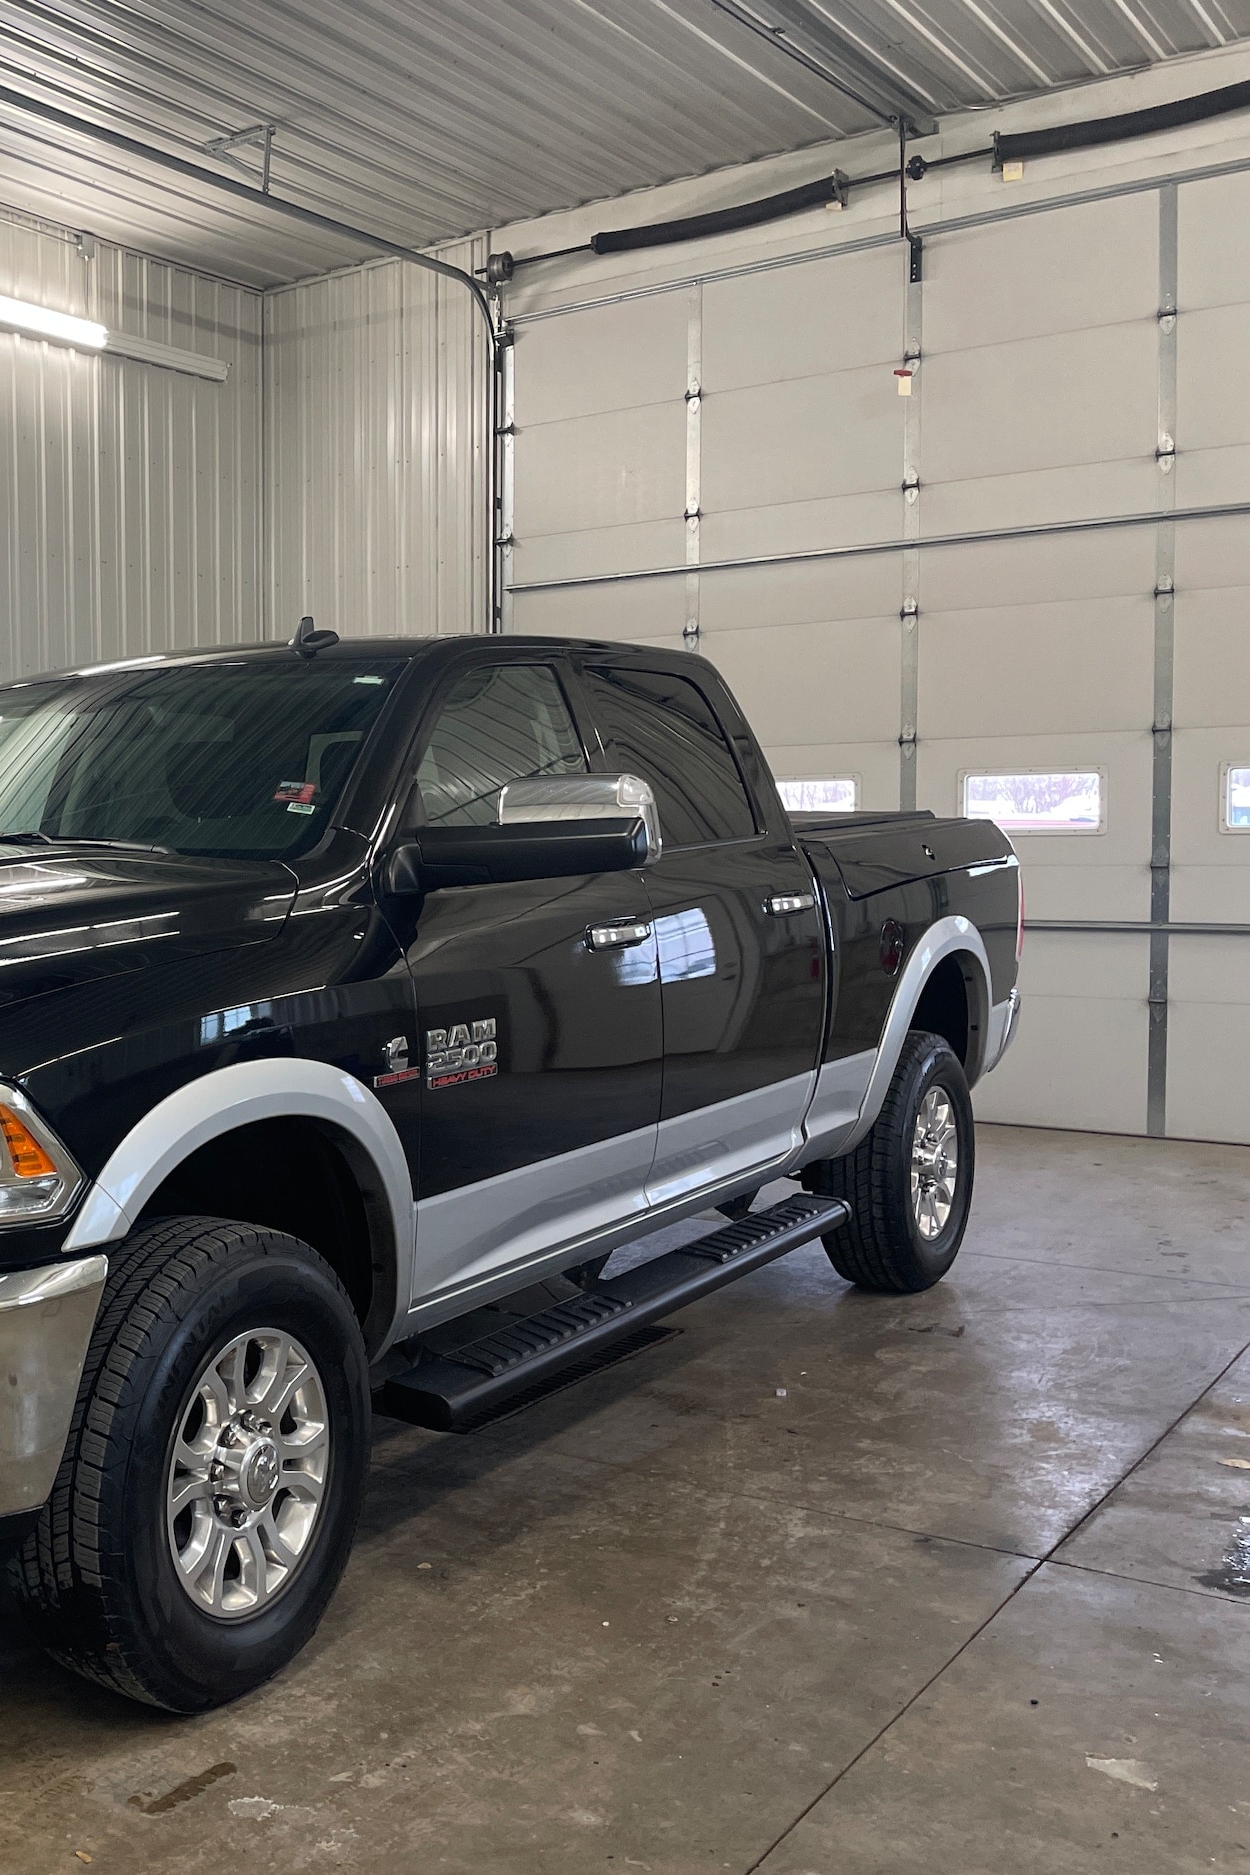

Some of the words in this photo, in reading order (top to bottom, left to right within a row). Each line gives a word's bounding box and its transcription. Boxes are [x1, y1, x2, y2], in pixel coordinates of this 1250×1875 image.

[426, 1017, 497, 1050] RAM
[426, 1040, 498, 1071] 2500
[431, 1070, 467, 1088] HEAVY
[467, 1064, 496, 1080] DUTY
